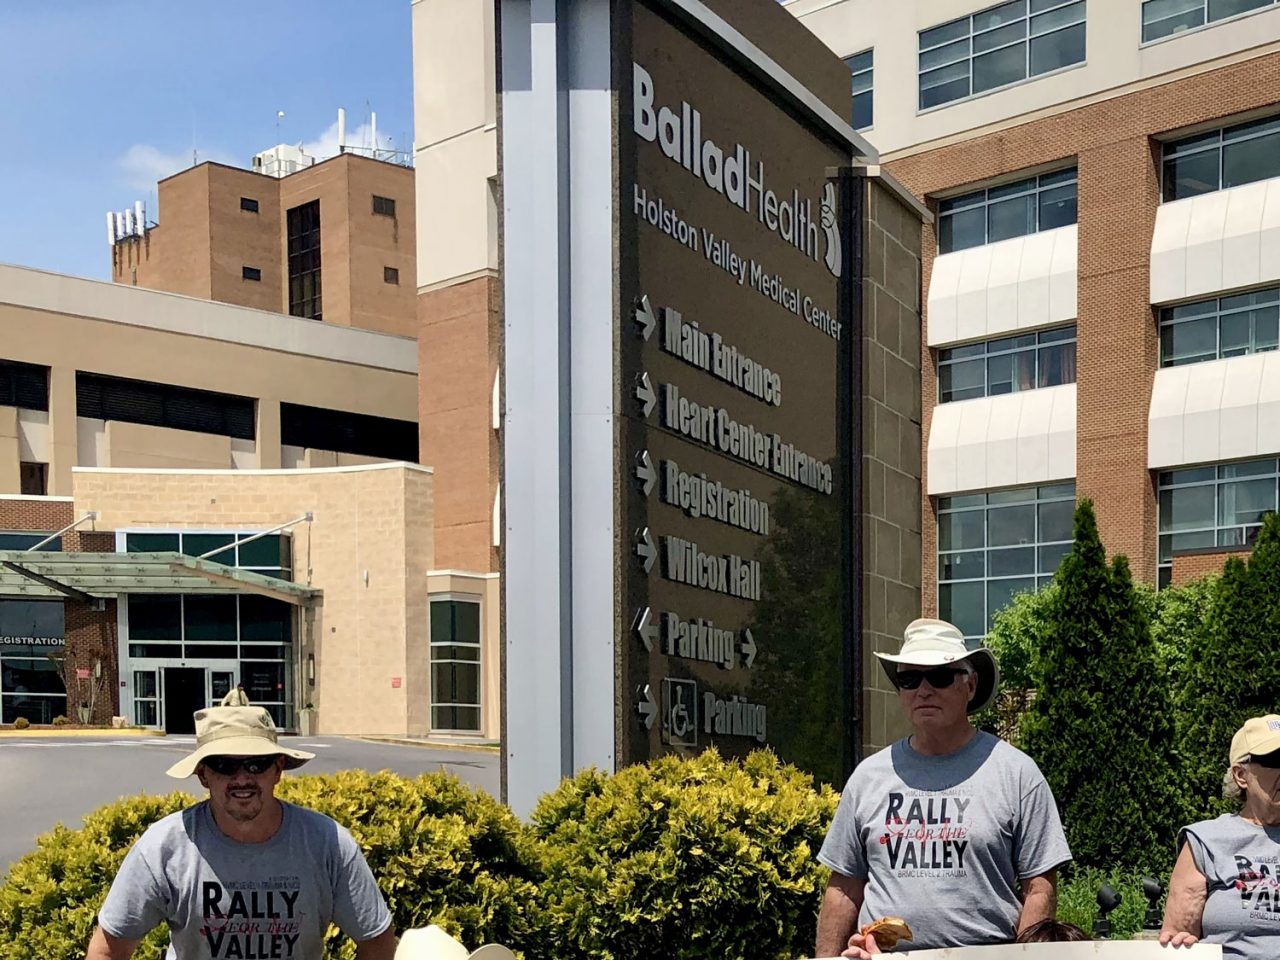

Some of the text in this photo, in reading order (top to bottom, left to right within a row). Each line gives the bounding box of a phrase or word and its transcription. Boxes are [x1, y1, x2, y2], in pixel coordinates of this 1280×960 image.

[633, 184, 842, 341] Holston Valley Medical Center
[665, 307, 781, 407] Main Entrance
[665, 383, 832, 495] Heart Center Entrance
[665, 458, 769, 536] Registration
[667, 535, 761, 601] Wilcox Hall
[666, 611, 734, 671] Parking
[704, 691, 767, 742] Parking
[885, 793, 970, 825] RALLY
[885, 833, 968, 869] VALLEY
[203, 881, 299, 919] RALLY
[204, 926, 300, 959] VALLEY
